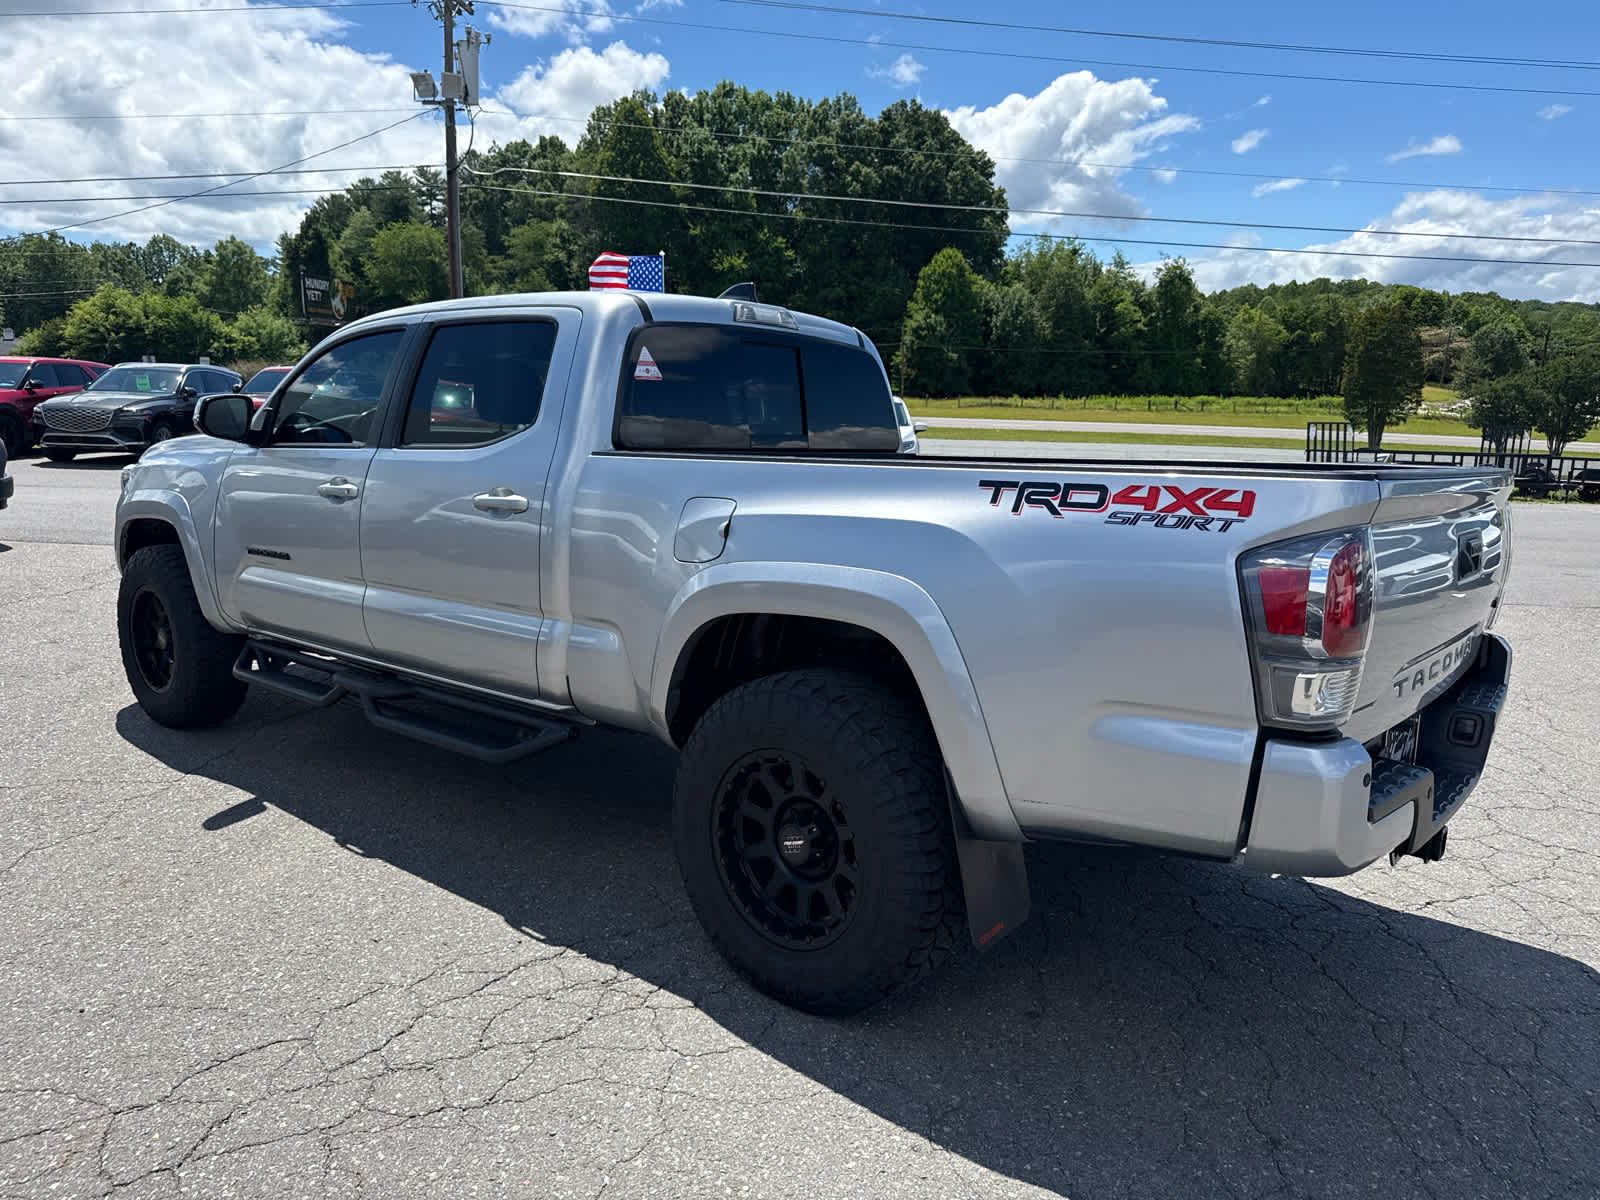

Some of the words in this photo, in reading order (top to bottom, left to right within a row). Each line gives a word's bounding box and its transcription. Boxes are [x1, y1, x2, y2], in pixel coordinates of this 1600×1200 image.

[979, 480, 1112, 519] TRD
[1111, 485, 1257, 518] 4X4
[1104, 511, 1247, 533] SPORT
[1393, 637, 1473, 698] TACOMA
